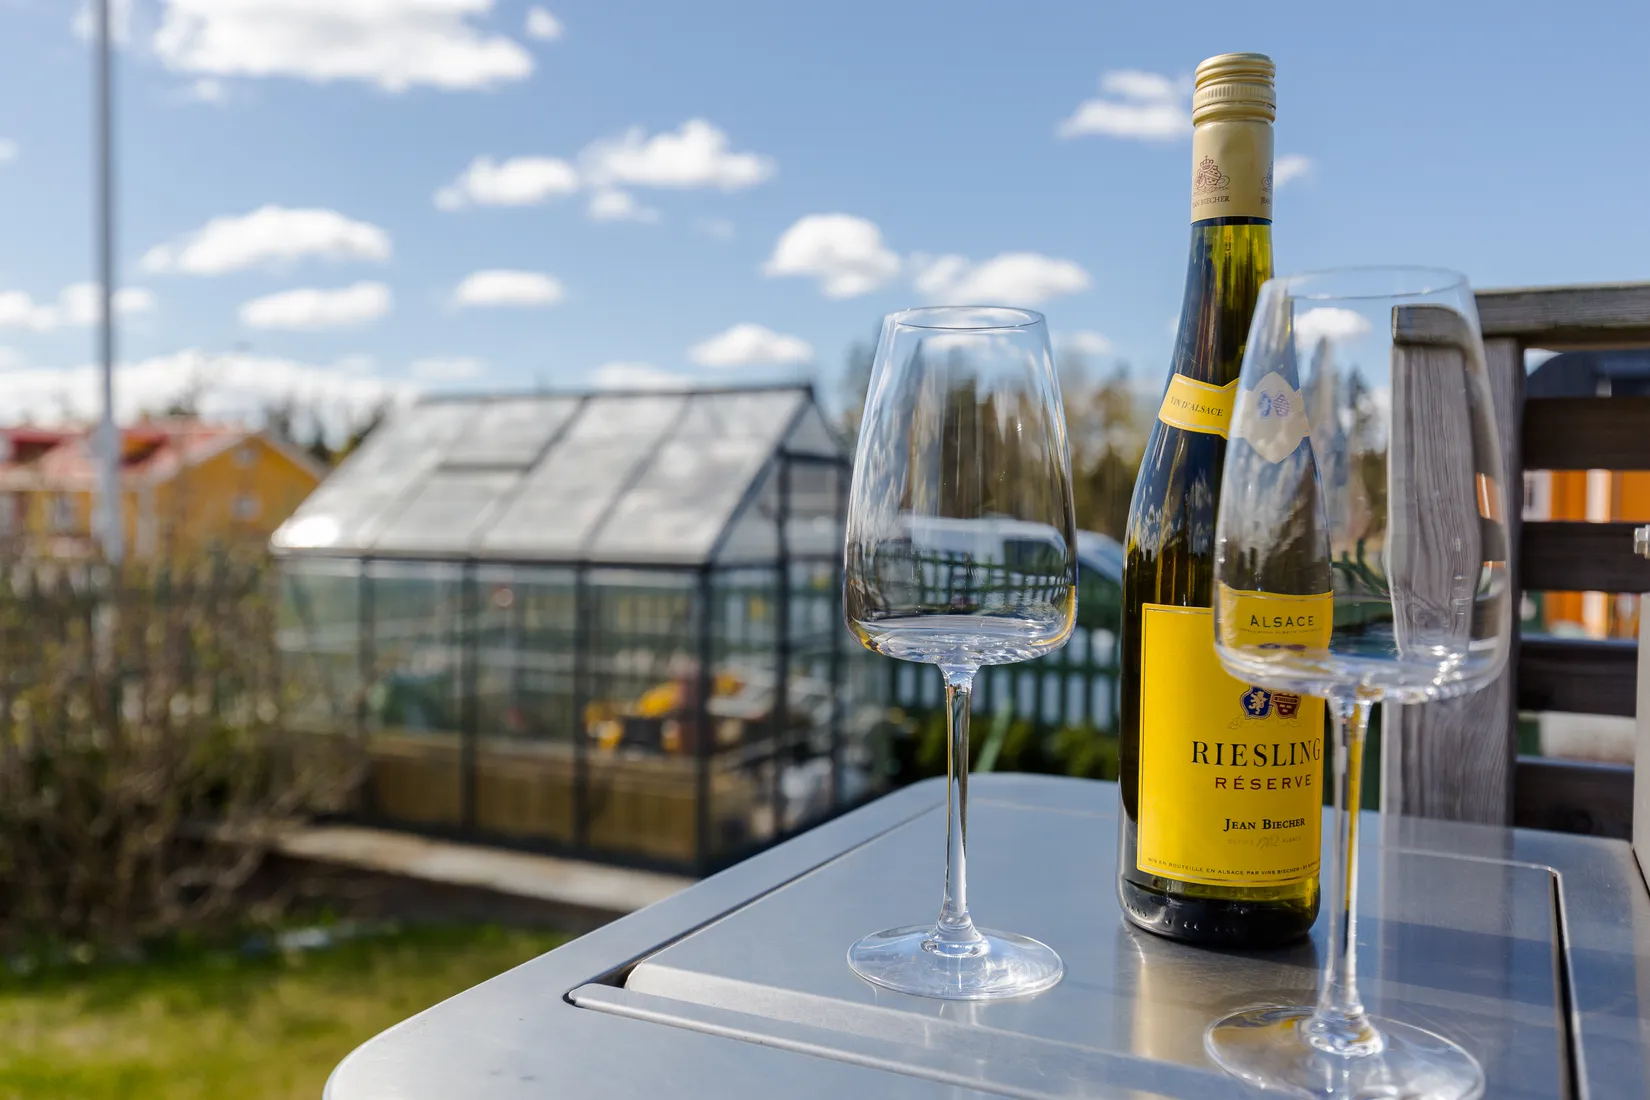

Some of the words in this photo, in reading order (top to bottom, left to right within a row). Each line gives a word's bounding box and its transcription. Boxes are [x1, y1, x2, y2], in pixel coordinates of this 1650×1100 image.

[1170, 396, 1180, 406] VIN
[1181, 400, 1224, 417] D'ALSACE
[1250, 614, 1314, 628] ALSACE
[1191, 738, 1321, 767] RIESLING
[1215, 774, 1312, 790] RÉSERVE
[1168, 862, 1204, 873] BOUTEILLE
